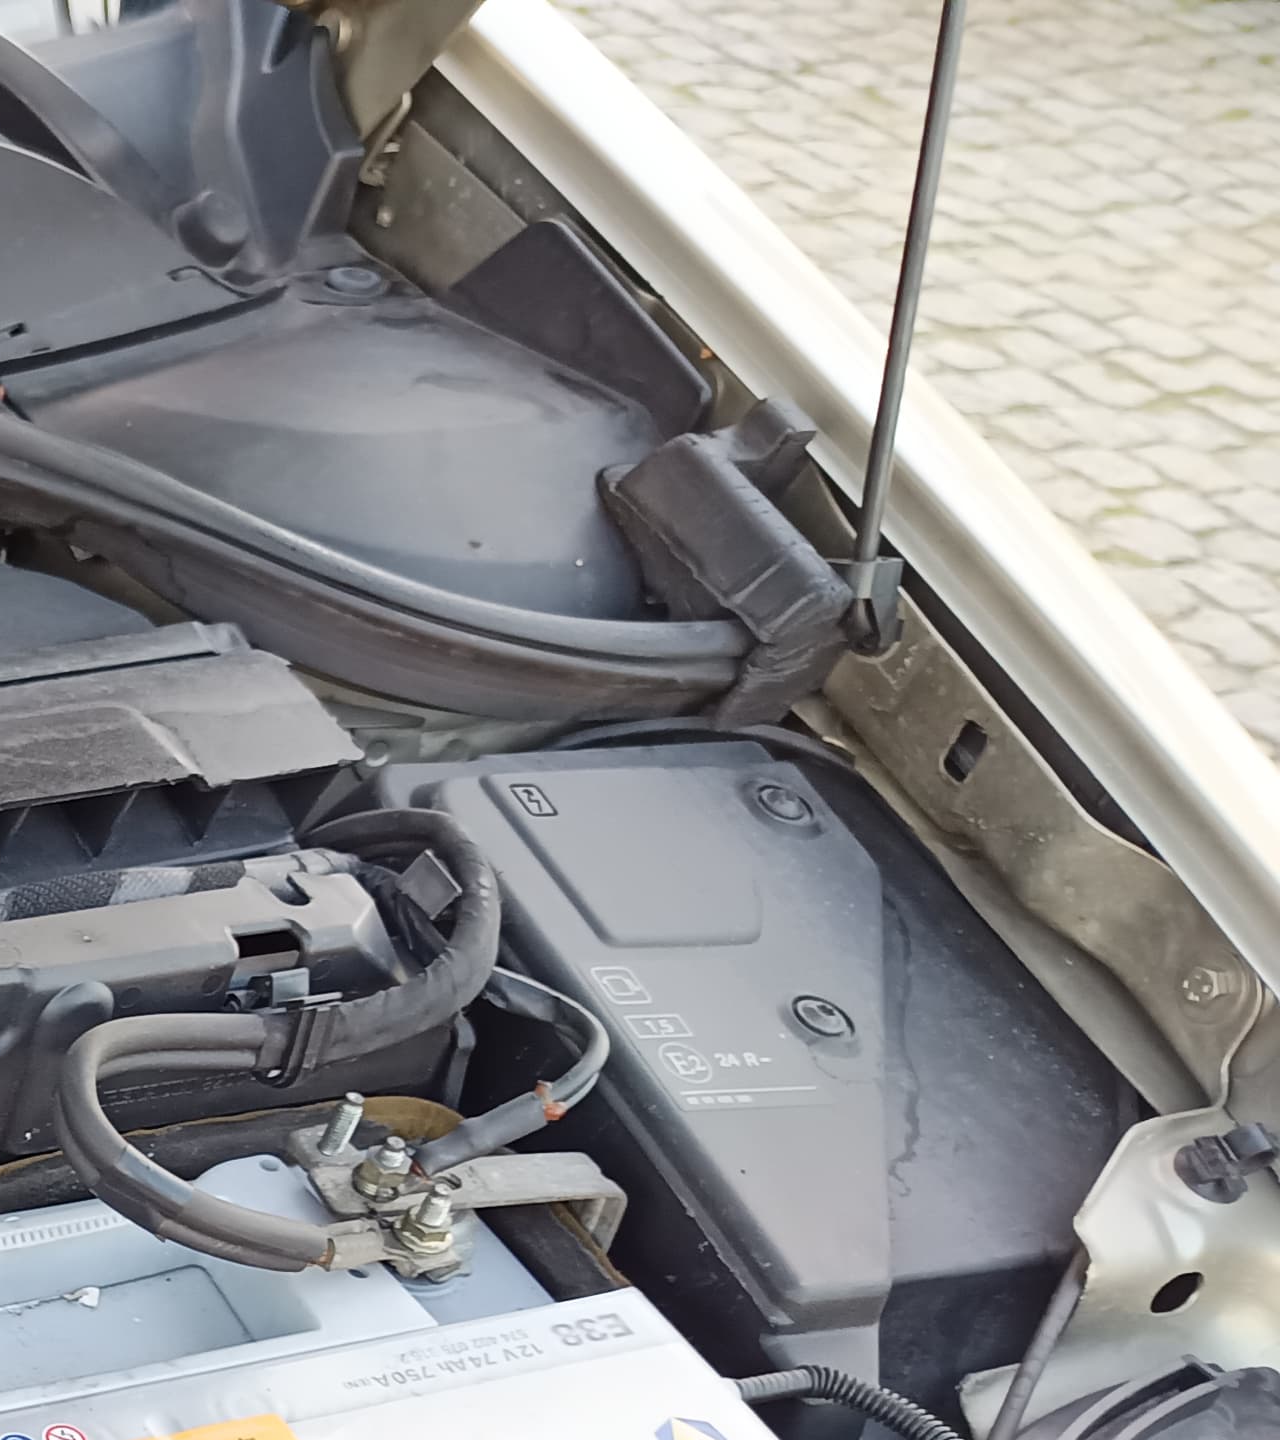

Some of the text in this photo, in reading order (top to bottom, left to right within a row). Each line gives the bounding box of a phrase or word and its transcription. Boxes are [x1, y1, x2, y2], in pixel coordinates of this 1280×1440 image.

[664, 1052, 708, 1075] E2
[551, 1313, 635, 1347] E38
[504, 1343, 544, 1361] 12V
